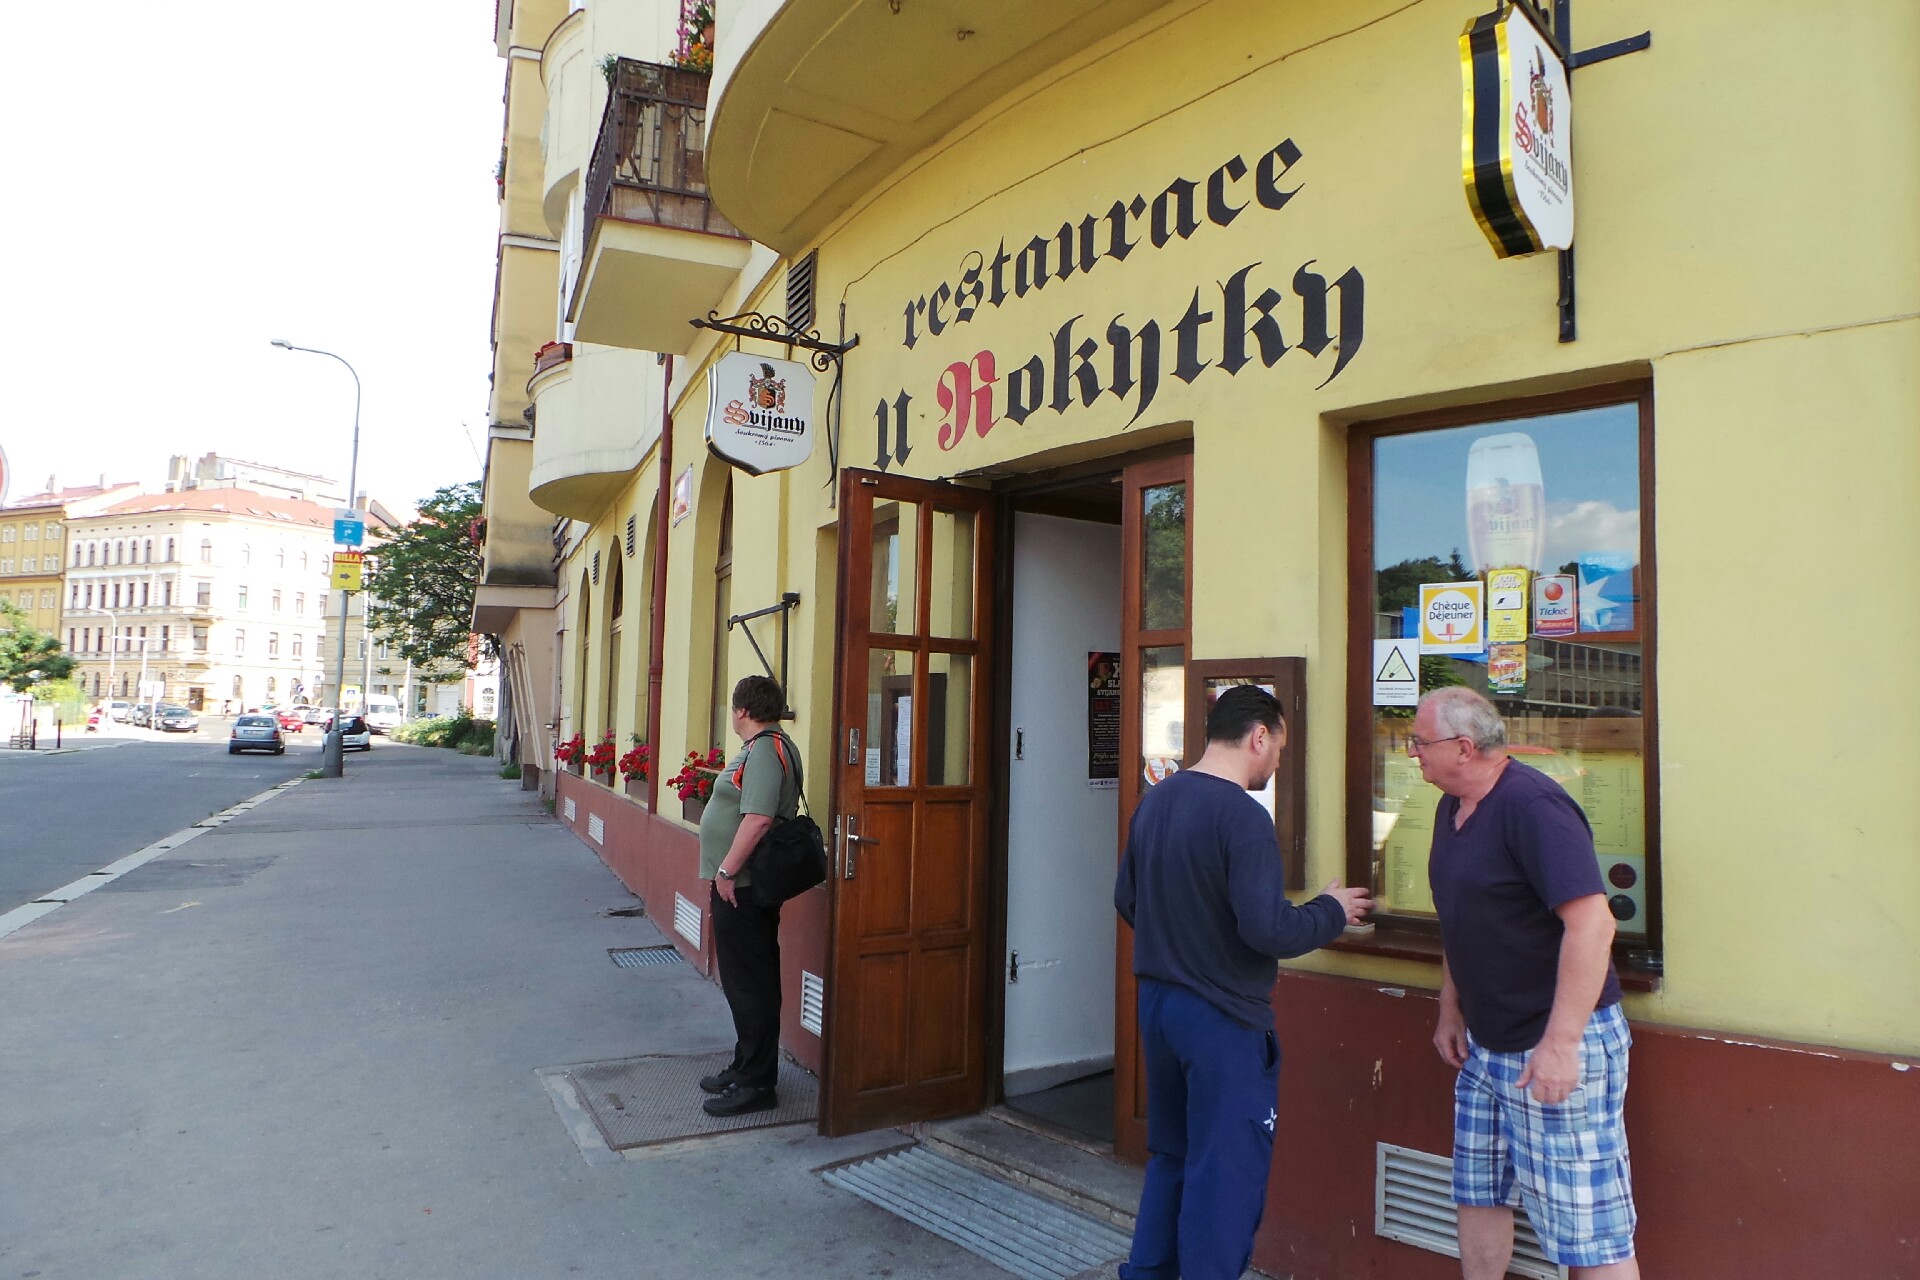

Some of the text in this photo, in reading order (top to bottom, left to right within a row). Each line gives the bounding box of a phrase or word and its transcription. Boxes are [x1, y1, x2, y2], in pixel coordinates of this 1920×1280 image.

[1515, 101, 1568, 197] Svijany
[903, 137, 1305, 350] restaurace
[873, 259, 1364, 472] u Rokytky
[723, 399, 805, 437] Svijany
[334, 552, 360, 562] BILLA
[1429, 611, 1473, 622] Déjeuner
[1432, 601, 1471, 611] Chèque
[1539, 607, 1568, 616] Ticket
